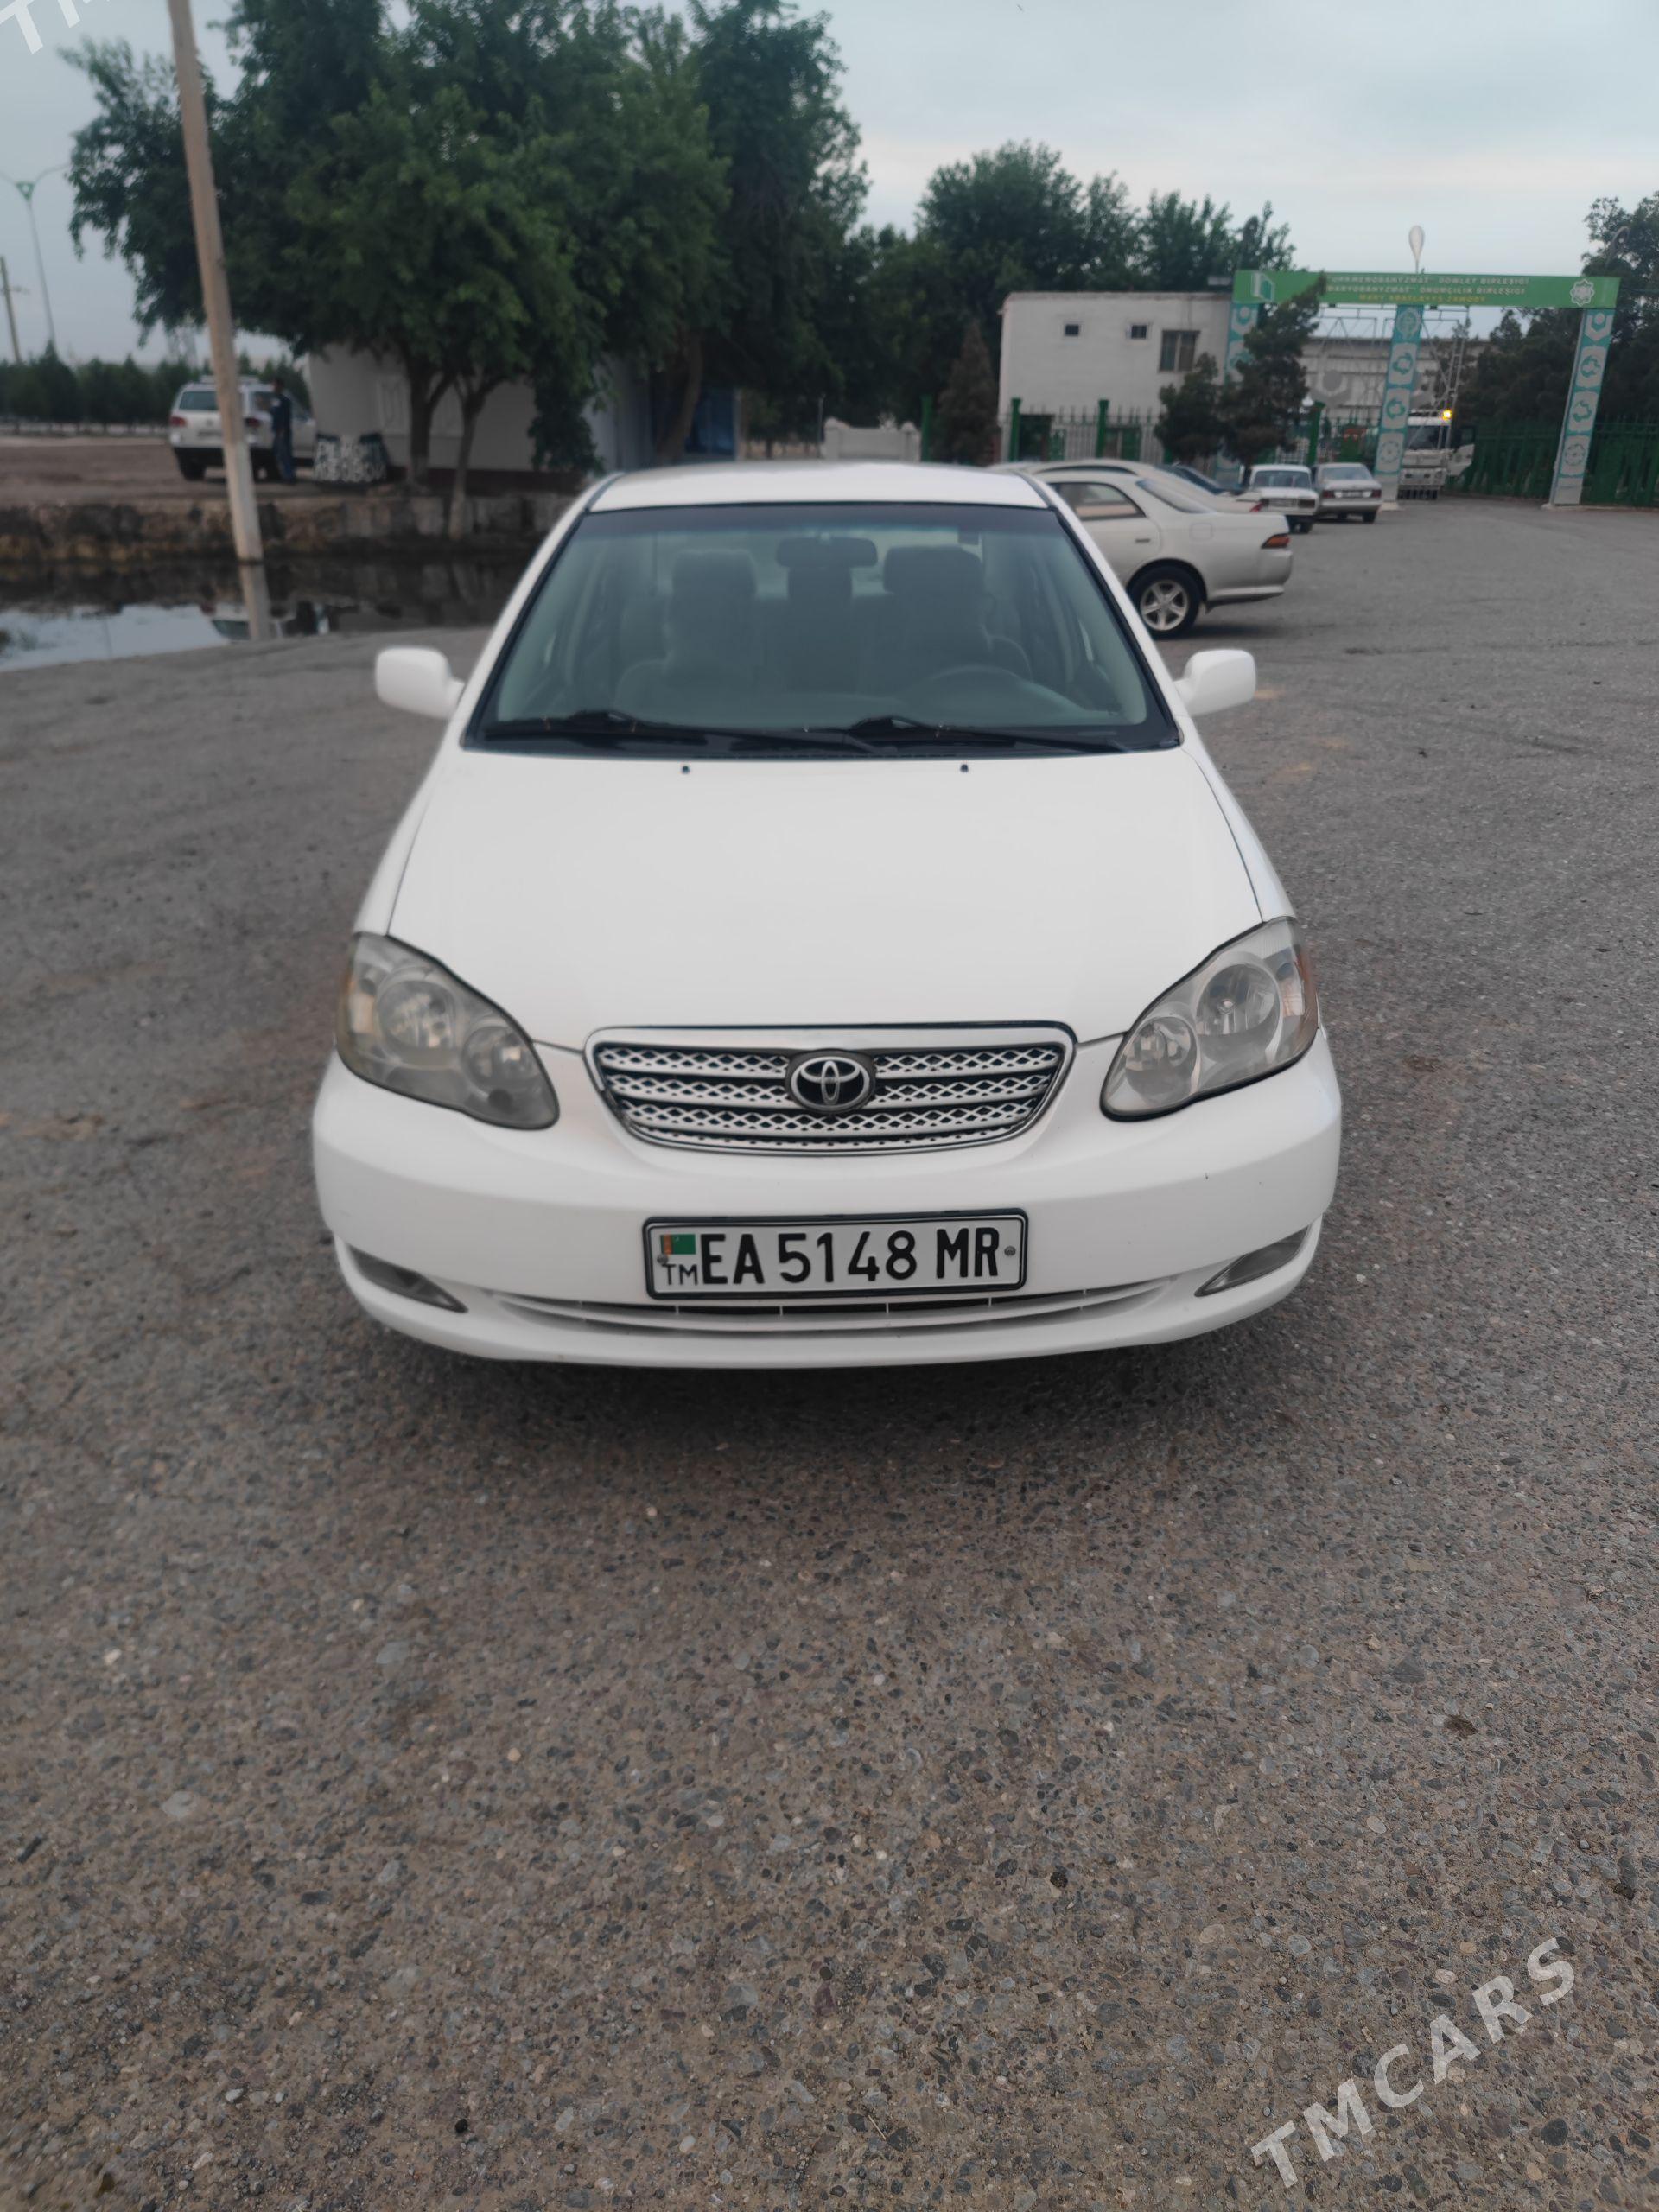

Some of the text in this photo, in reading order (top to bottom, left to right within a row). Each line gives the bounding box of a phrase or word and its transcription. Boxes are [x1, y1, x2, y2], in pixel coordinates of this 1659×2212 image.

[661, 1226, 1000, 1286] TM EA 5148 MR
